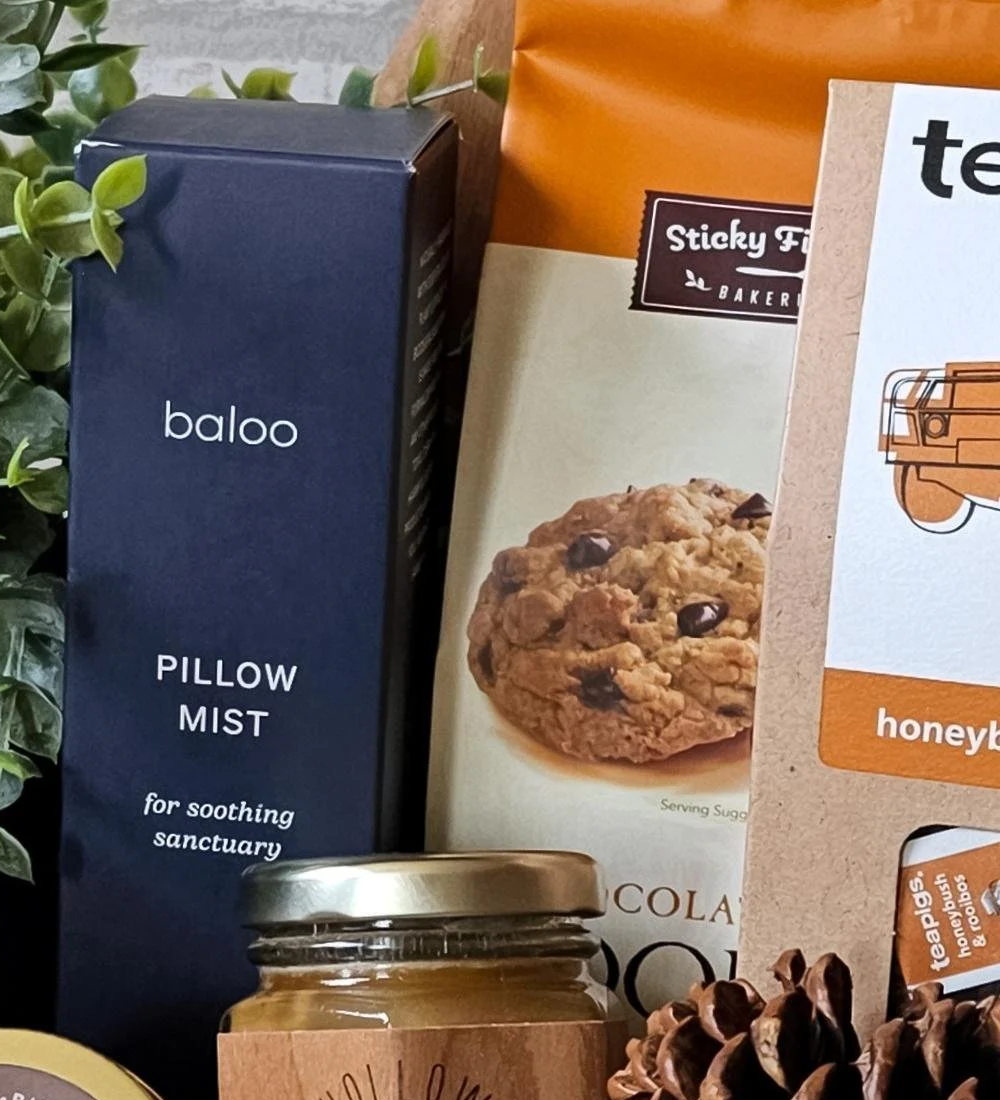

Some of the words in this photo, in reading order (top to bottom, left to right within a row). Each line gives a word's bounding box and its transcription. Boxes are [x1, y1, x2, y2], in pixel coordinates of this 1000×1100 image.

[912, 119, 1000, 199] te
[666, 218, 766, 259] Sticky
[164, 400, 299, 448] baloo
[157, 654, 298, 692] PILLOW
[179, 703, 270, 737] MIST
[143, 792, 181, 816] for
[186, 801, 295, 830] soothing
[660, 798, 710, 818] Serving
[153, 831, 282, 862] sanctuary
[934, 872, 972, 958] honeybush
[953, 873, 983, 932] rooibos
[972, 933, 988, 948] &
